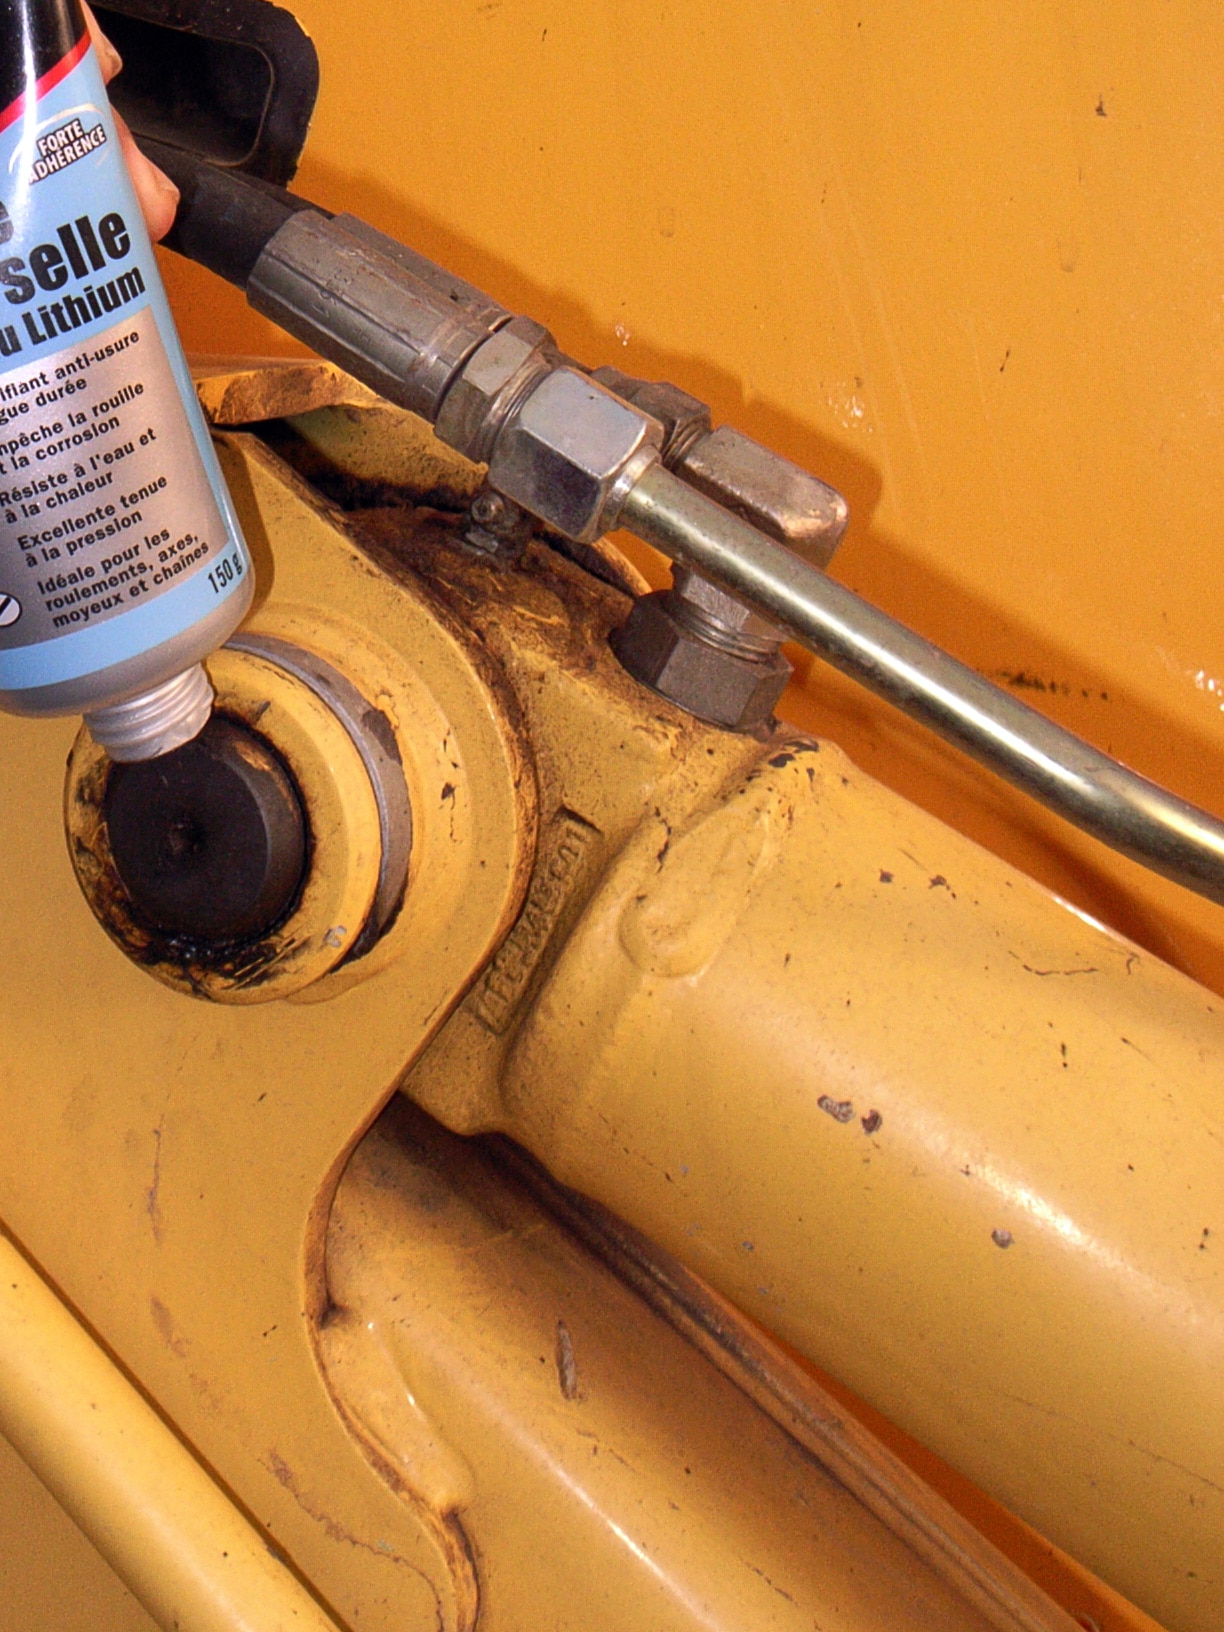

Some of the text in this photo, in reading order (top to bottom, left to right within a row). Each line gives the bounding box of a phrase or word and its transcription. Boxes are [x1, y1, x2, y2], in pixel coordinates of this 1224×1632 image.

[37, 118, 84, 157] FORTE
[26, 266, 145, 346] Lithium
[55, 331, 139, 379] anti-usure
[36, 375, 87, 406] durée
[69, 412, 87, 427] la
[92, 383, 144, 416] rouille
[11, 454, 31, 471] la
[36, 416, 120, 460] corrosion
[74, 462, 86, 478] à
[90, 441, 135, 470] l'eau
[139, 427, 157, 445] et
[4, 471, 114, 524] à la chaleur
[18, 476, 168, 551] Excellente tenue
[25, 511, 143, 568] à la pression
[37, 529, 171, 595] Idéale pour les
[46, 535, 199, 611] roulements, axes,
[53, 542, 209, 628] moyeux et chaînes
[207, 552, 243, 594] 150 g
